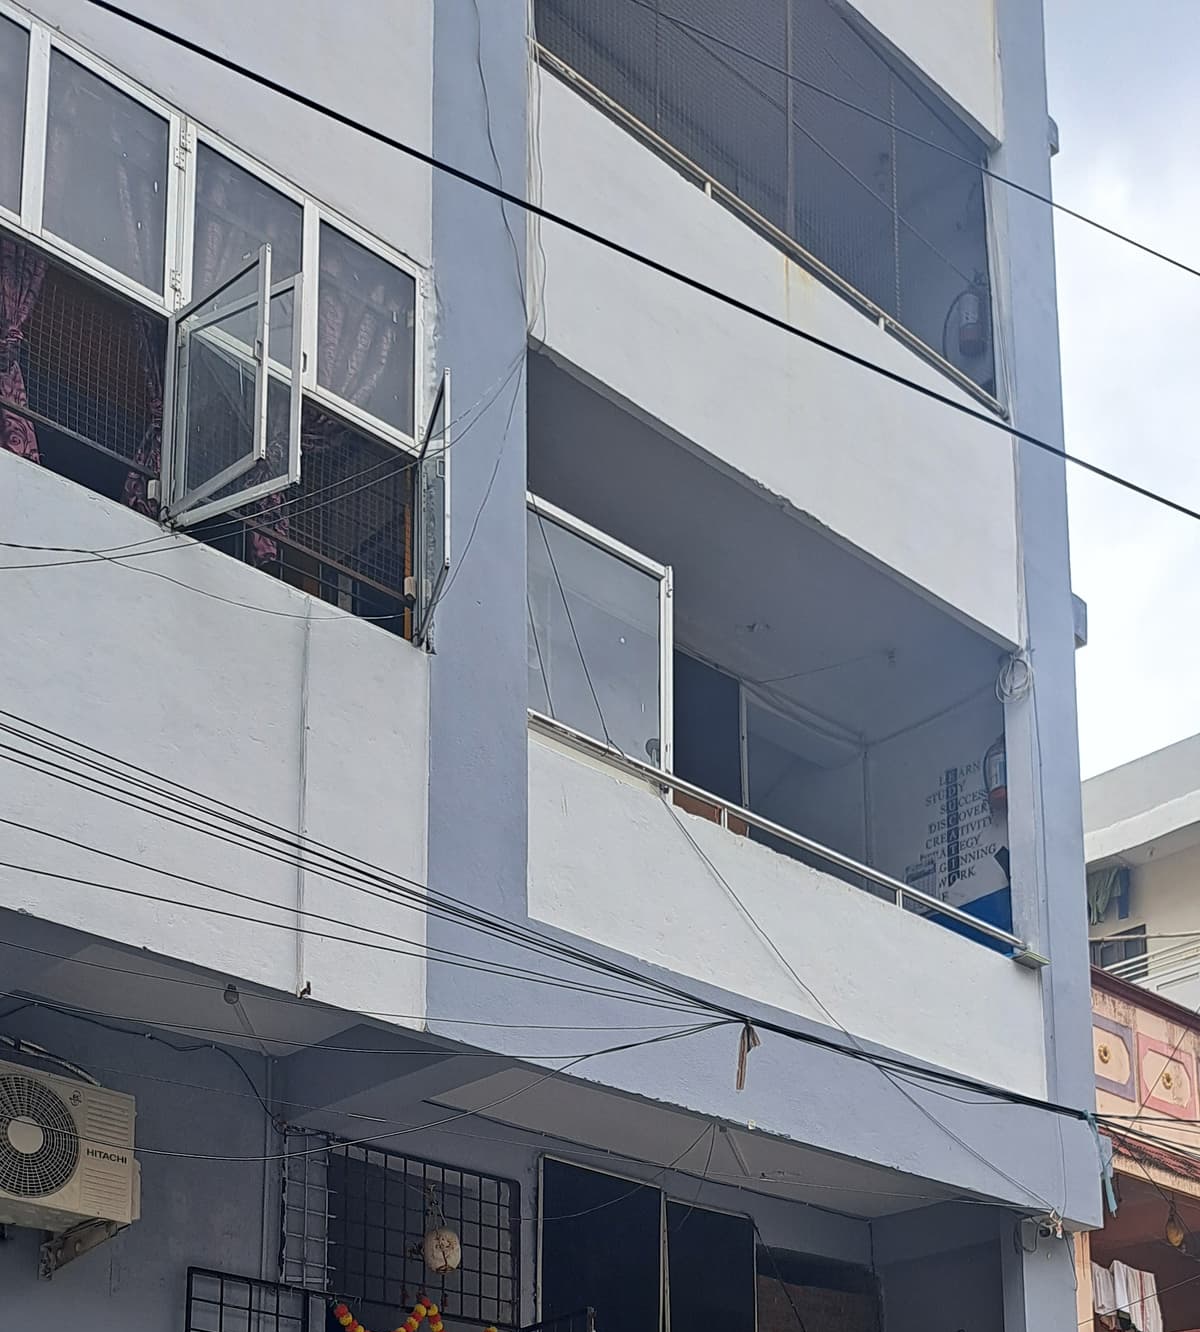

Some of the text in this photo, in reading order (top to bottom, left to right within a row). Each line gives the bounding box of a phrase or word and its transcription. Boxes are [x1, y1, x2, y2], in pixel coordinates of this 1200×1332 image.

[939, 761, 981, 787] LEARN
[925, 781, 966, 807] STUDY
[925, 815, 993, 850] CREATIVITY
[86, 1148, 127, 1164] HITACHI
